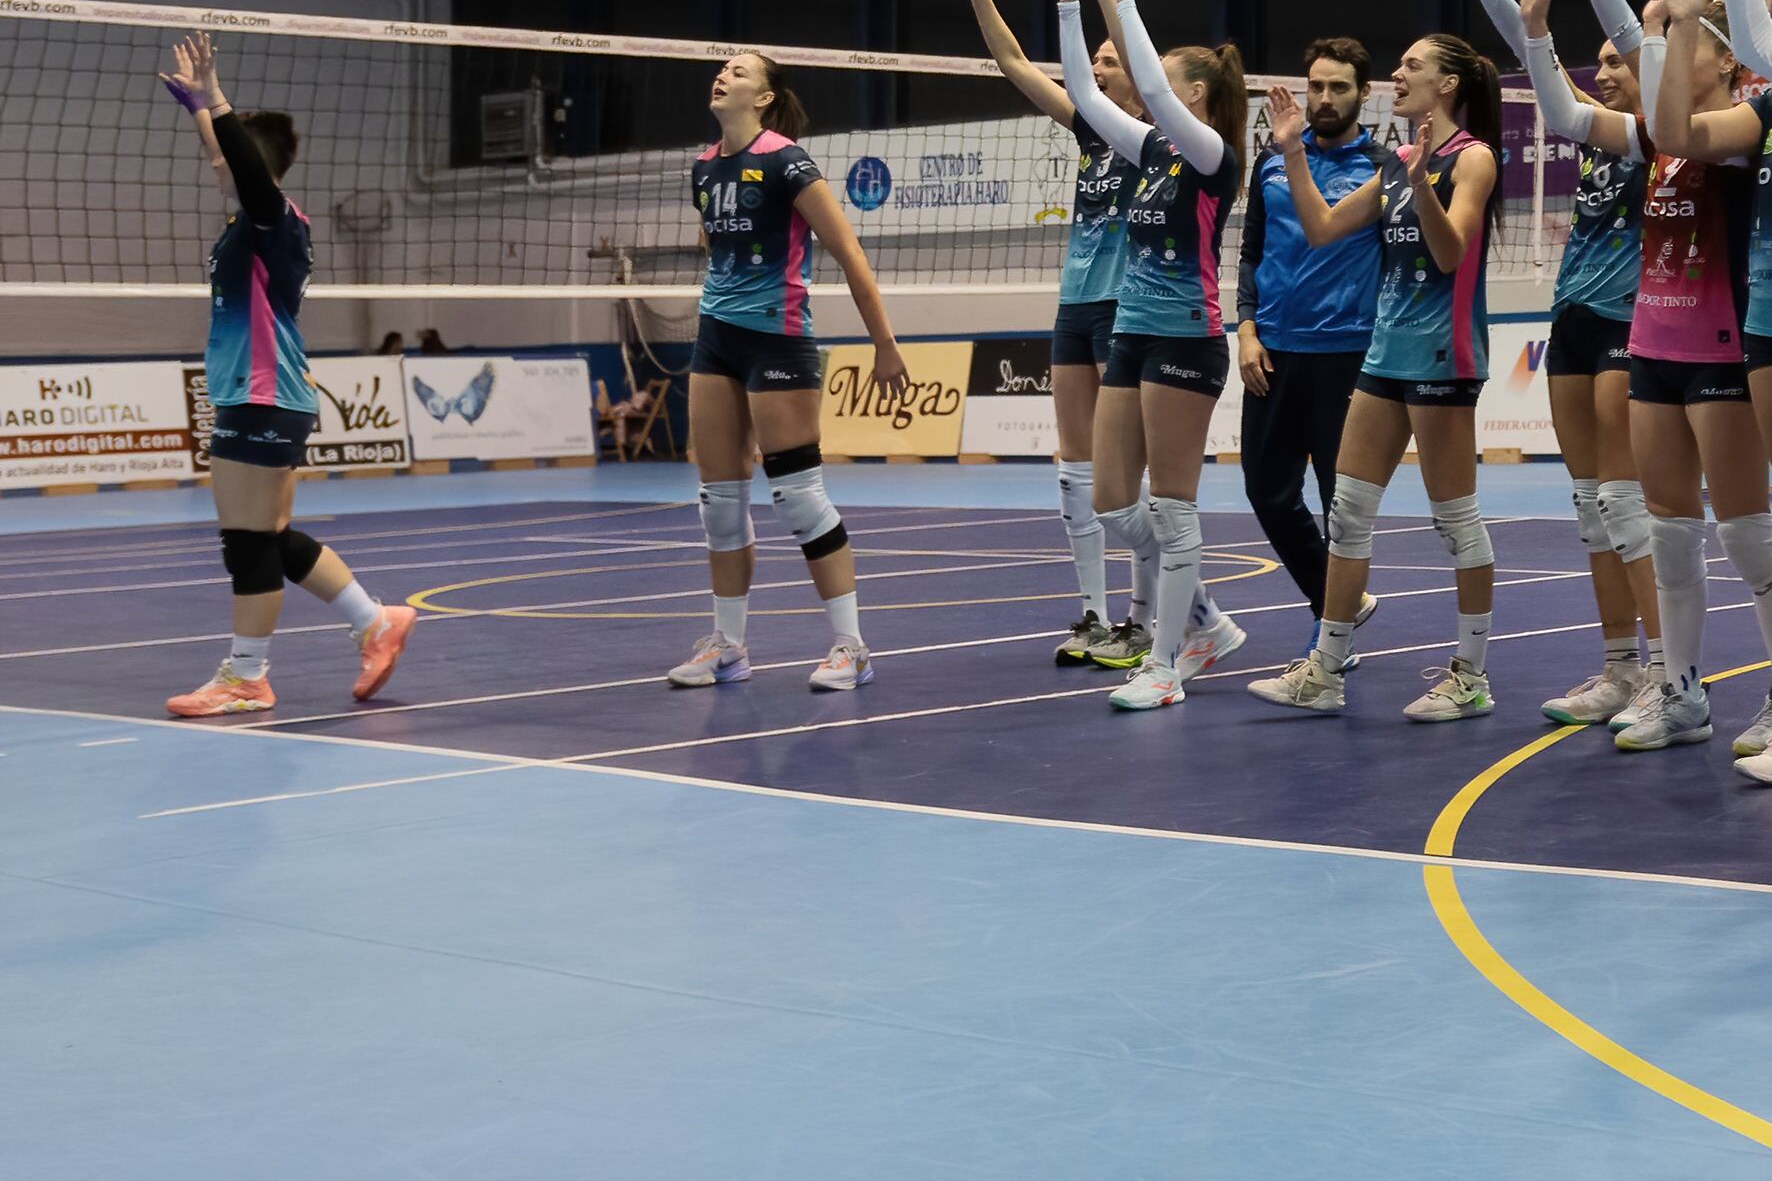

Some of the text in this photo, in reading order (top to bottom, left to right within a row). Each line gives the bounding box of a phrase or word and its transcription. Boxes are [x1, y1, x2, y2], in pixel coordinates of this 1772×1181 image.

[201, 11, 271, 28] rfevb.com
[383, 24, 448, 39] rfevb.com
[552, 33, 611, 49] rfevb.com
[848, 54, 899, 67] rfevb.com
[967, 151, 983, 175] DE
[711, 181, 737, 217] 14
[1390, 185, 1414, 224] 2
[1383, 226, 1420, 245] cisa
[1662, 295, 1697, 308] TINTO
[1159, 363, 1203, 379] Muga
[829, 365, 961, 430] Muga
[60, 404, 149, 426] DIGITAL
[306, 443, 402, 466] (La Rioja)
[161, 458, 185, 470] Alta
